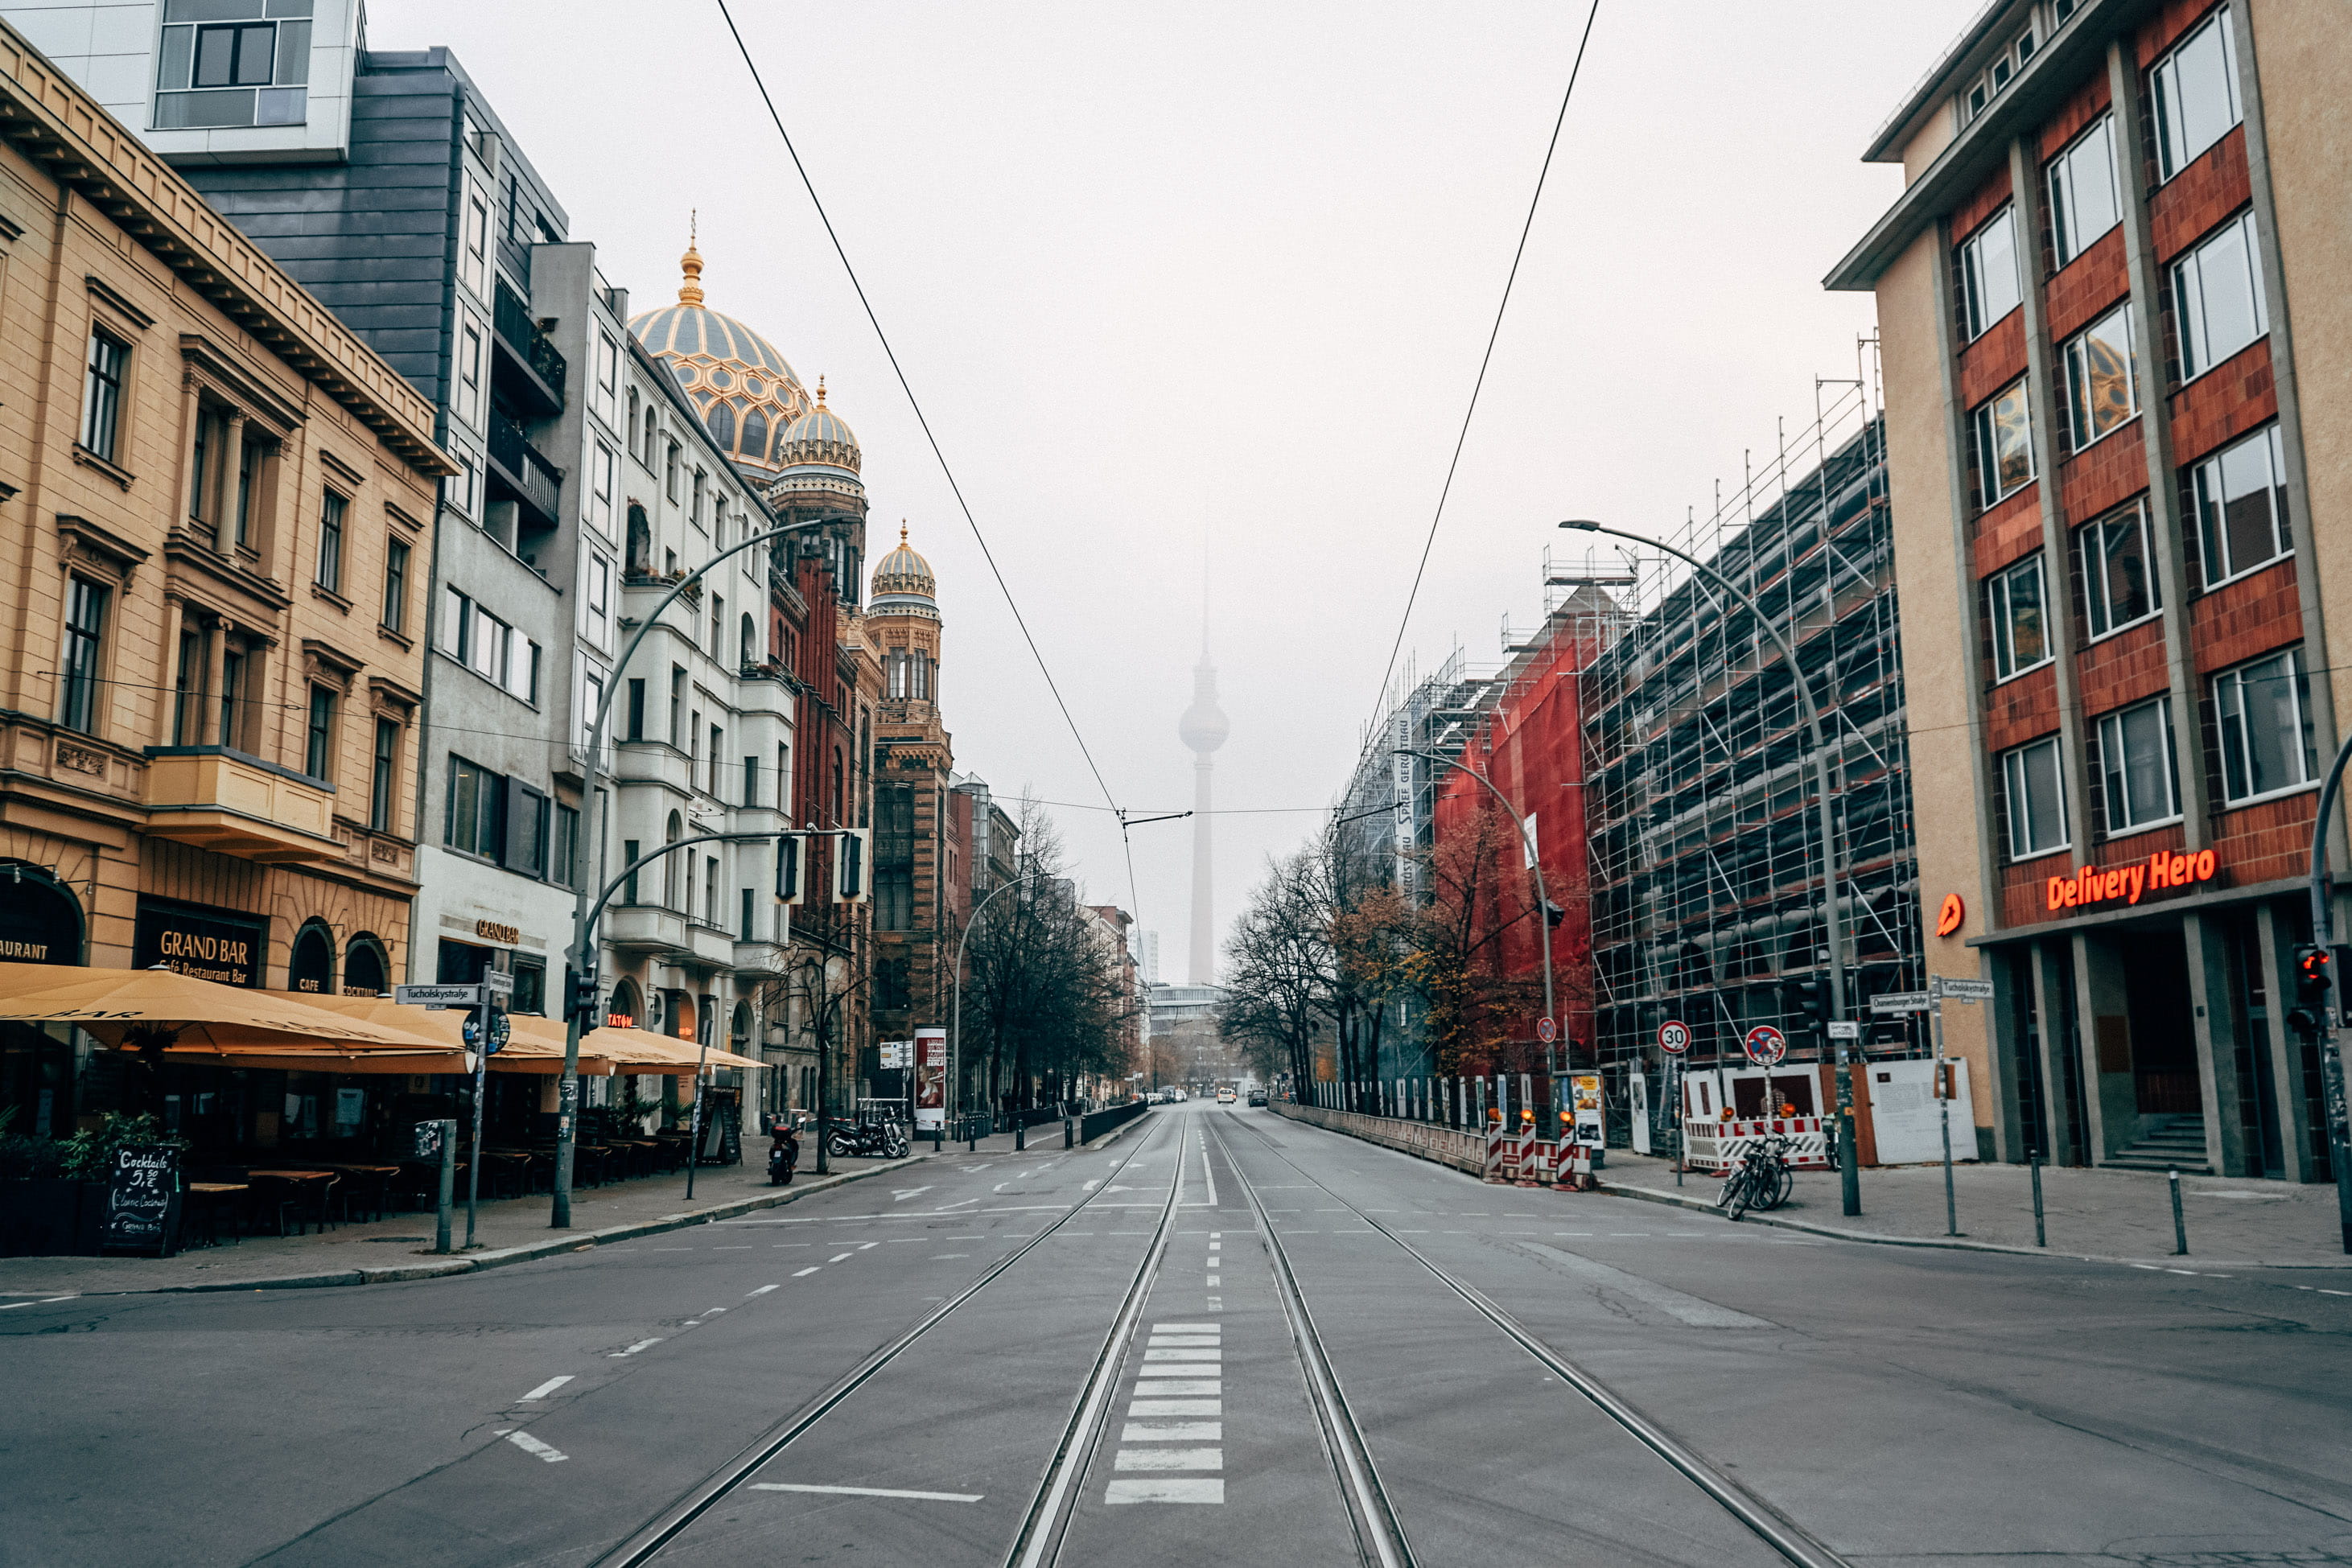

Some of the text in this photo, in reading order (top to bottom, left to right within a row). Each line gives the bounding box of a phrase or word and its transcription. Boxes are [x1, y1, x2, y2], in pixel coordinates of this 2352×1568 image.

[1397, 720, 1412, 824] SPREE GERÜTBAU
[2047, 850, 2216, 911] Delivery Hero
[476, 920, 519, 945] GRAND BAR
[161, 930, 248, 965] GRAND BAR
[183, 962, 230, 982] Restaurant
[232, 969, 247, 983] Bar
[299, 978, 319, 992] CAFE
[406, 989, 468, 1000] Tucholskystraße
[1666, 1030, 1684, 1044] 30
[120, 1151, 167, 1169] Cocktails
